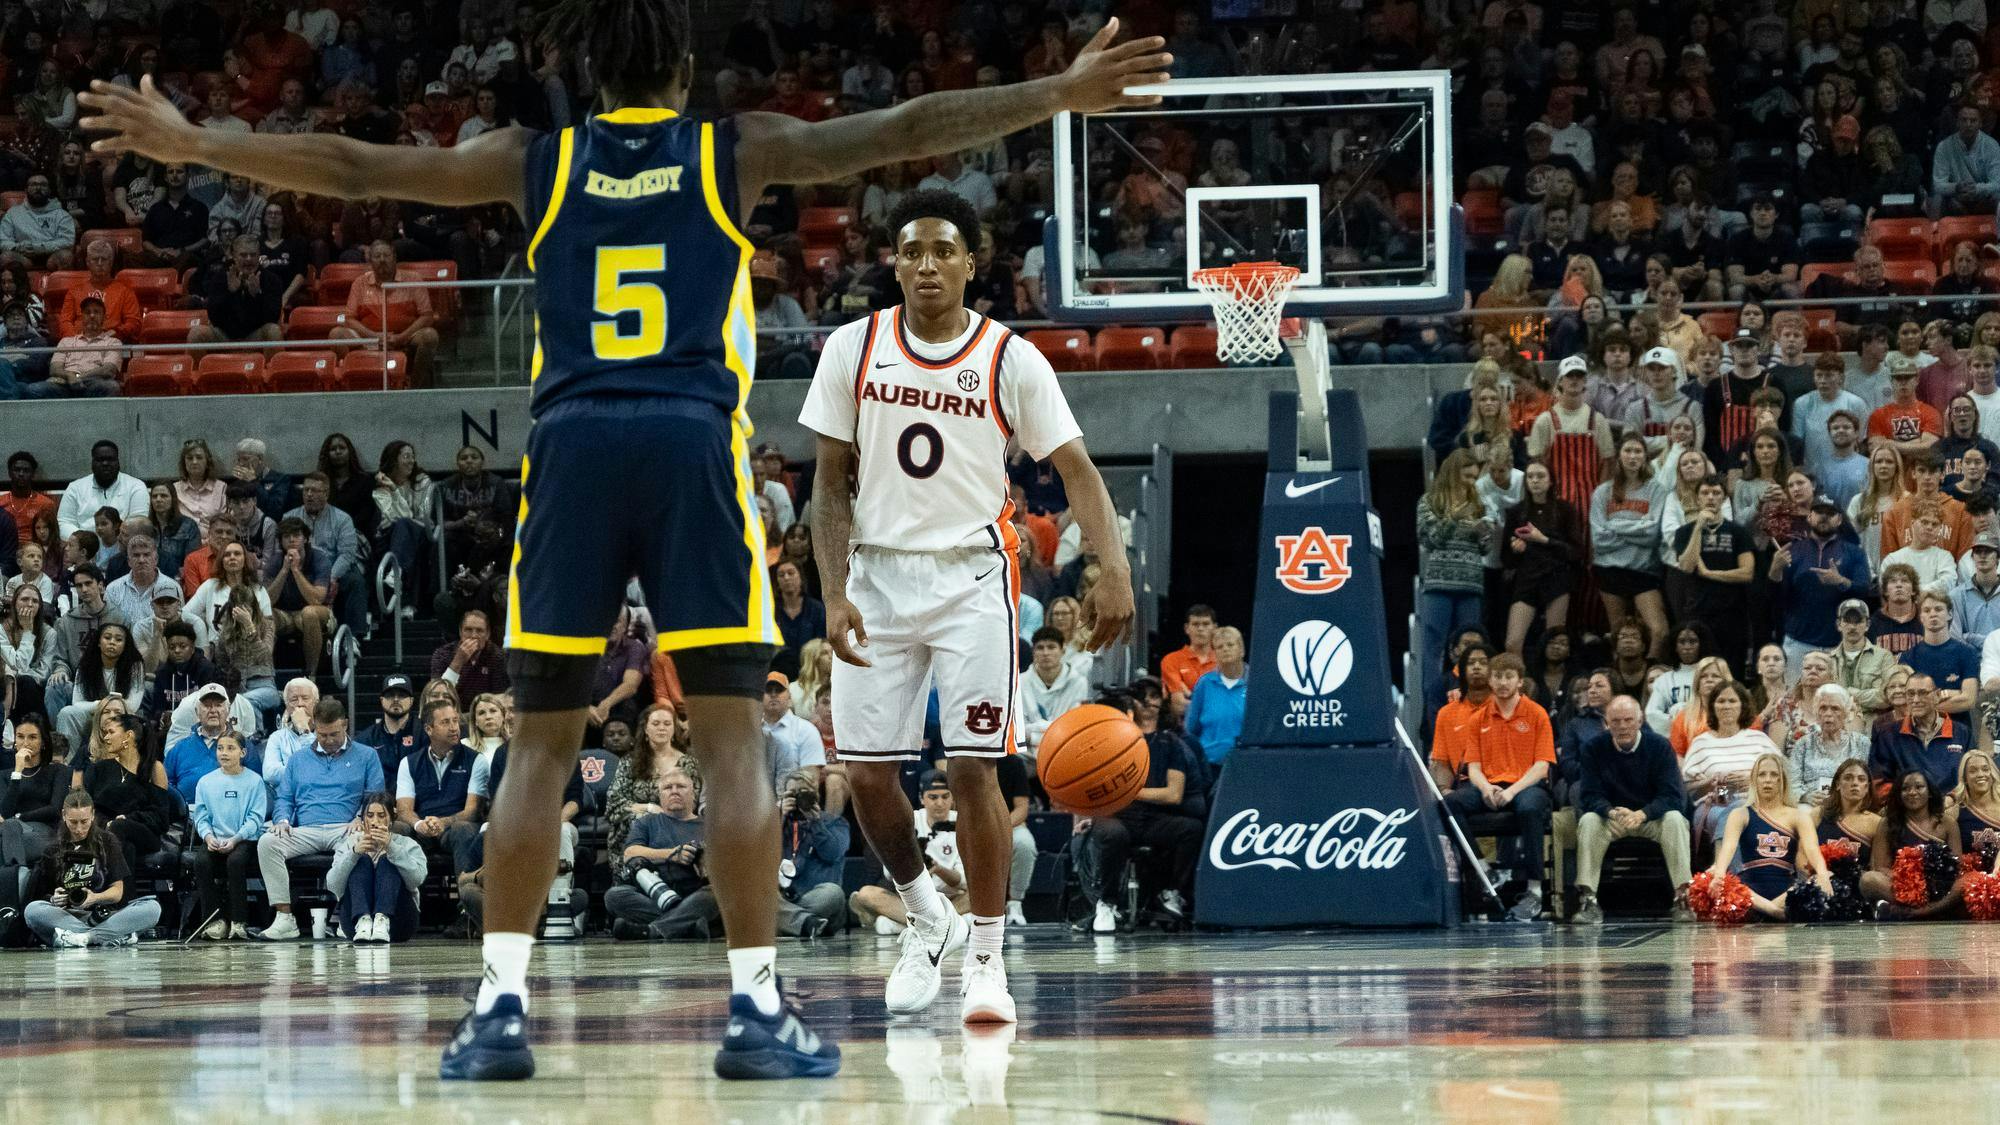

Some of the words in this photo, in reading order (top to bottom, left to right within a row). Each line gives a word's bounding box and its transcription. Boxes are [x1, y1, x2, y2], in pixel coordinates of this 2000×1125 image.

[584, 166, 683, 198] KENNEDY
[591, 243, 667, 360] 5
[1072, 298, 1110, 307] SPALDING
[861, 381, 988, 419] AUBURN
[959, 370, 980, 392] SEC
[462, 409, 498, 451] N
[897, 422, 945, 480] 0
[1290, 699, 1343, 712] WIND
[1208, 808, 1419, 871] Coca-Cola
